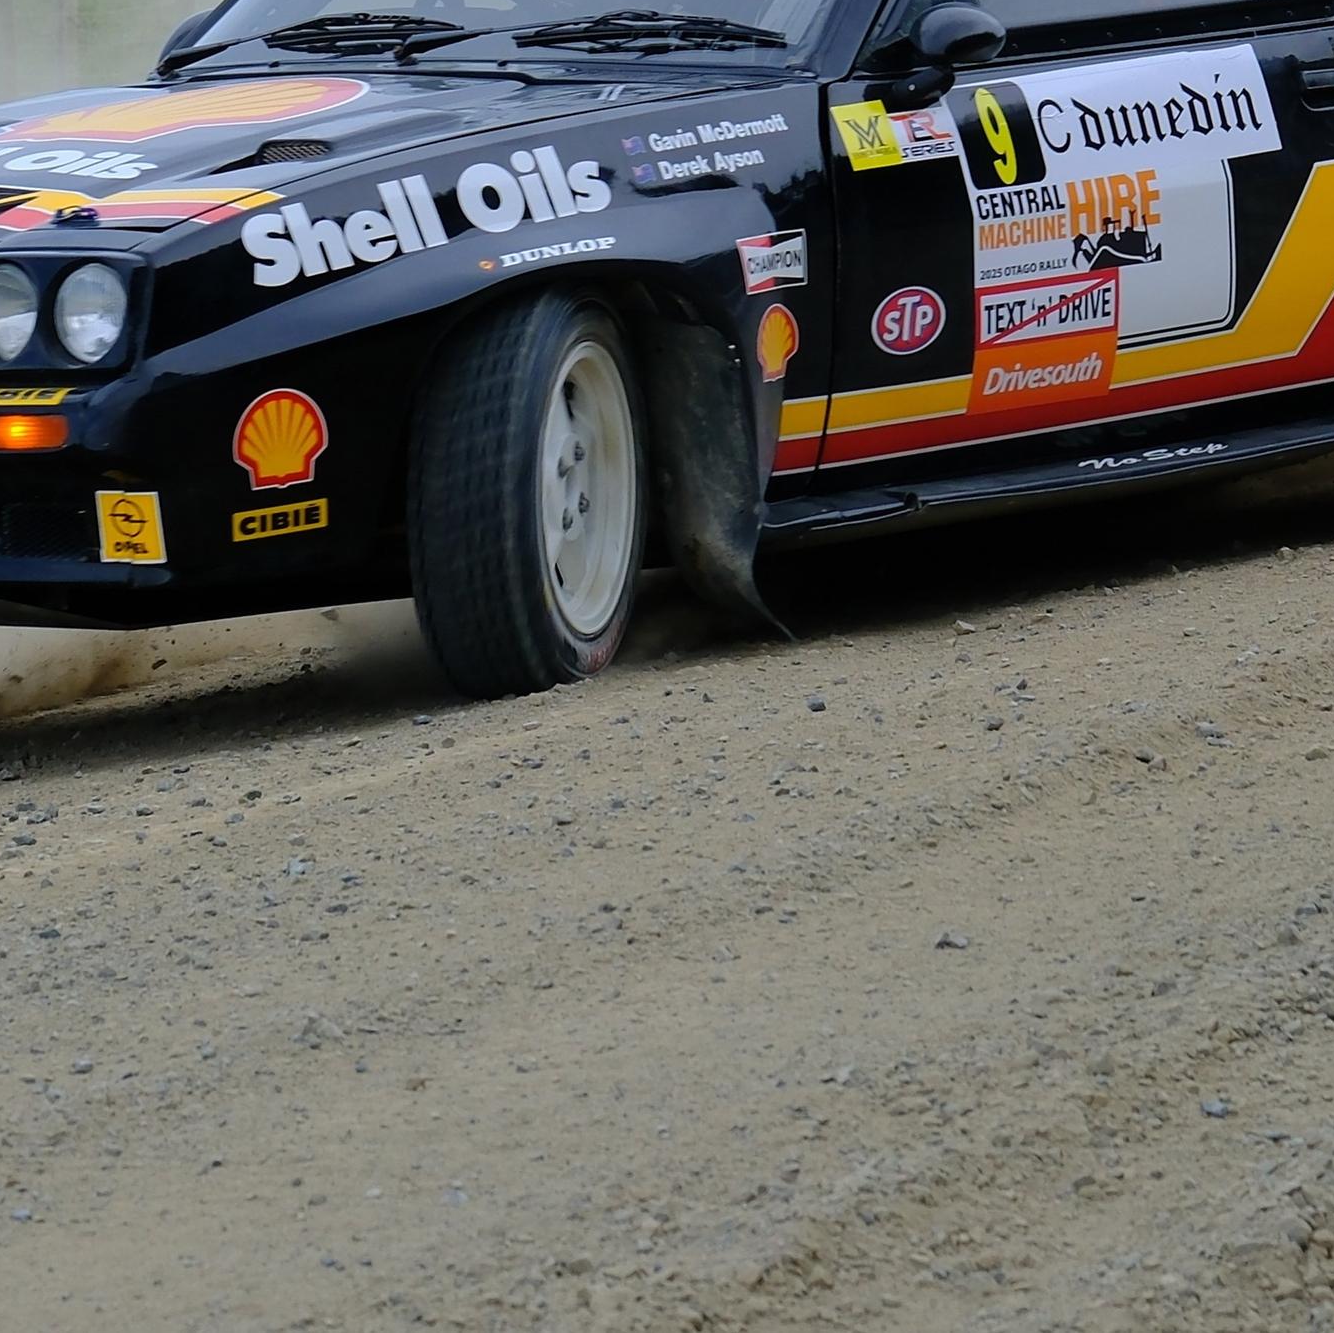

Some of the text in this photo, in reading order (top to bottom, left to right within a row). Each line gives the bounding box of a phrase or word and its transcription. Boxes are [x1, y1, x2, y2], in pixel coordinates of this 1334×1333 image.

[648, 114, 789, 152] Gavin McDermott
[901, 141, 956, 159] SERIES
[974, 87, 1017, 185] 9
[3, 149, 159, 180] Oils
[657, 149, 766, 180] Derek Ayson
[241, 145, 612, 287] Shell Oils
[976, 169, 1161, 238] CENTRAL HIRE
[979, 214, 1067, 251] MACHINE
[499, 235, 617, 267] DUNLOP
[747, 249, 803, 275] CHAMPION
[1004, 262, 1037, 277] OTAGO
[1039, 258, 1068, 271] RALLY
[882, 294, 934, 342] STP
[984, 300, 1027, 335] TEXT
[1058, 287, 1112, 324] DRIVE
[982, 351, 1103, 396] Drivesouth
[1142, 442, 1229, 461] Step
[114, 540, 149, 555] OPEL
